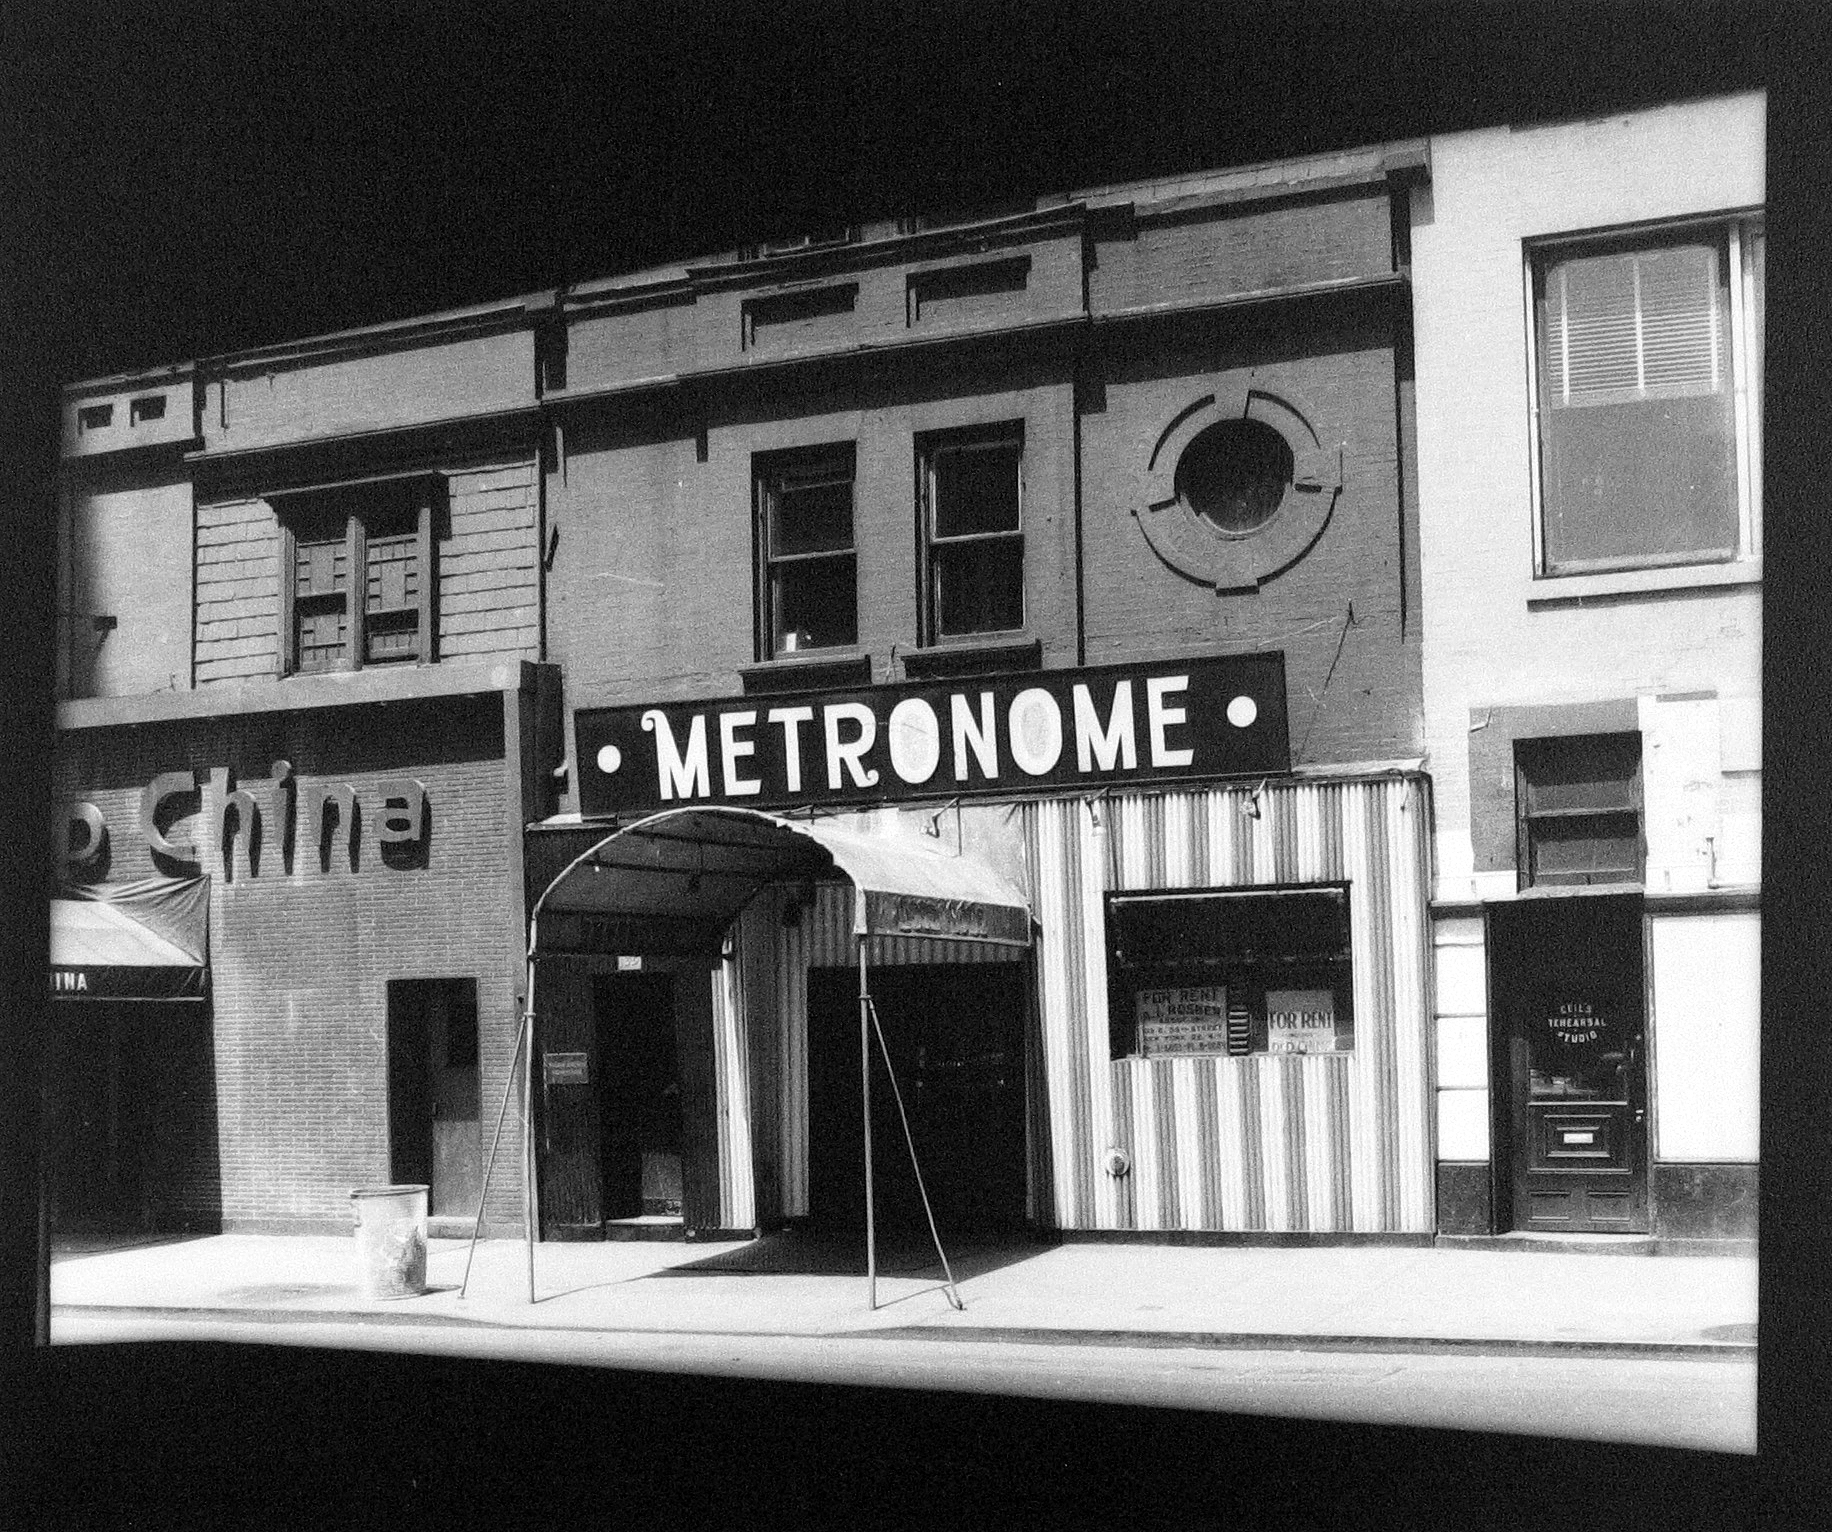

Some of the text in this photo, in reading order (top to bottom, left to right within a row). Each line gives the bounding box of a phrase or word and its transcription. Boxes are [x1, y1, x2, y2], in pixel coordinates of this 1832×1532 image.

[640, 674, 1195, 800] METRONOME
[140, 760, 425, 866] China
[1269, 1011, 1332, 1030] FOR RENT
